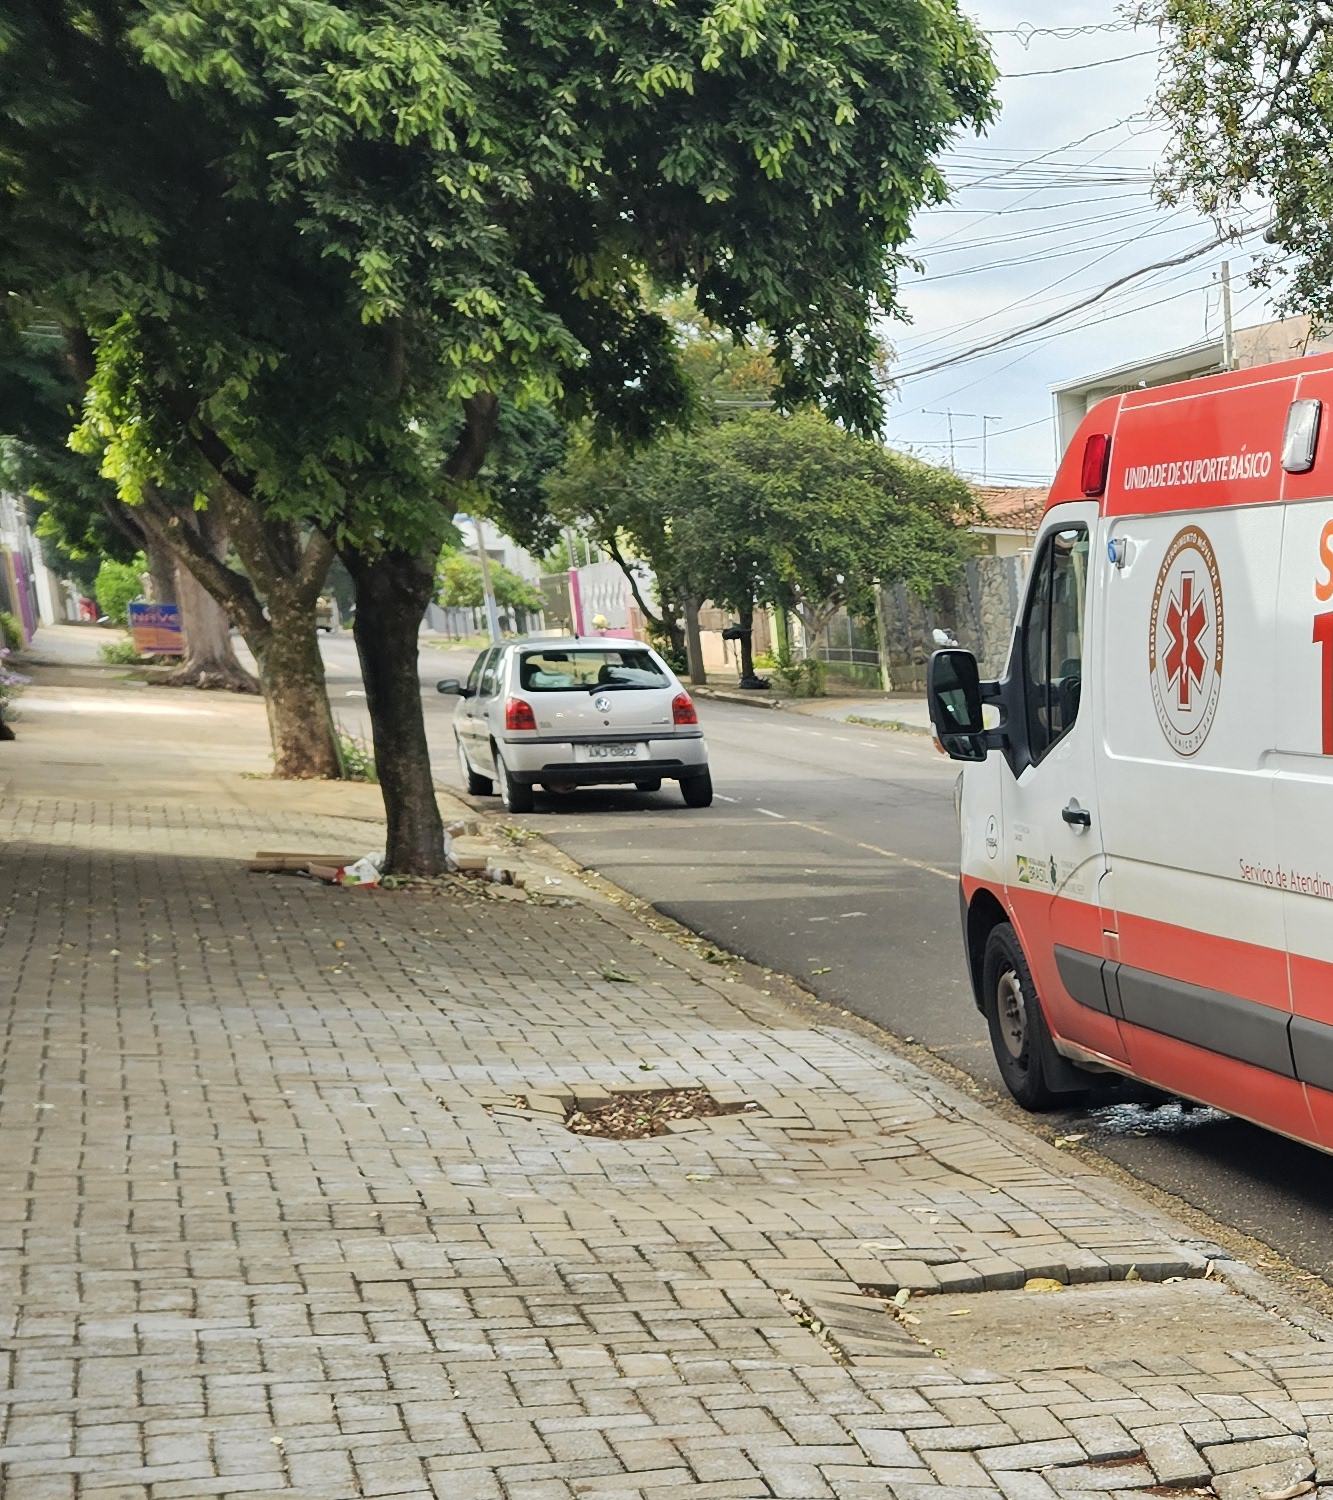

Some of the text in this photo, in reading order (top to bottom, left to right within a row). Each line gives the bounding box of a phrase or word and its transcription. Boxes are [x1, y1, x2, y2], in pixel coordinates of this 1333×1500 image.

[1123, 444, 1272, 490] UNIDADE DE SUPORTE BÁSICO
[1239, 858, 1274, 889] Serviço
[1275, 864, 1288, 888] de
